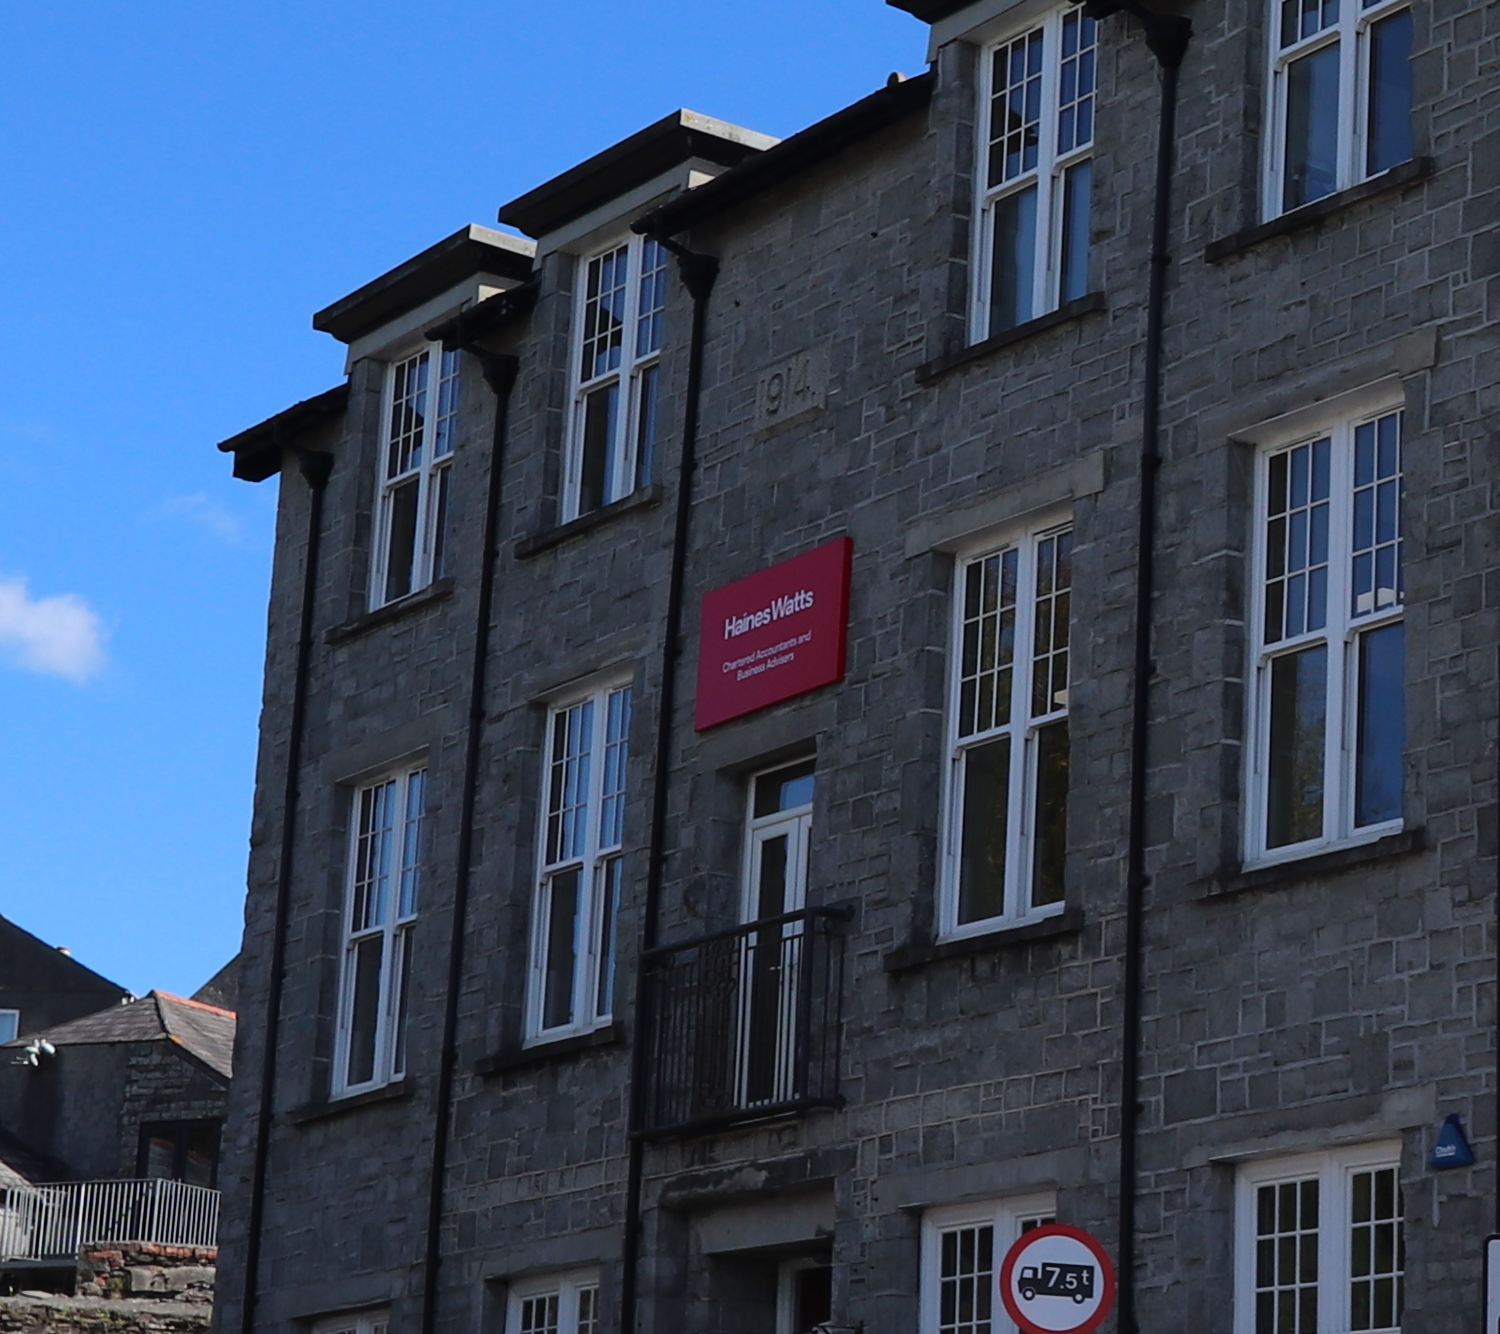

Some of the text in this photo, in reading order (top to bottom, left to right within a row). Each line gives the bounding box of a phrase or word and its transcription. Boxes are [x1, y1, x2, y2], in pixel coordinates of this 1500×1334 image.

[722, 629, 812, 673] Chartered Accountants and
[736, 652, 795, 681] Business Advisers
